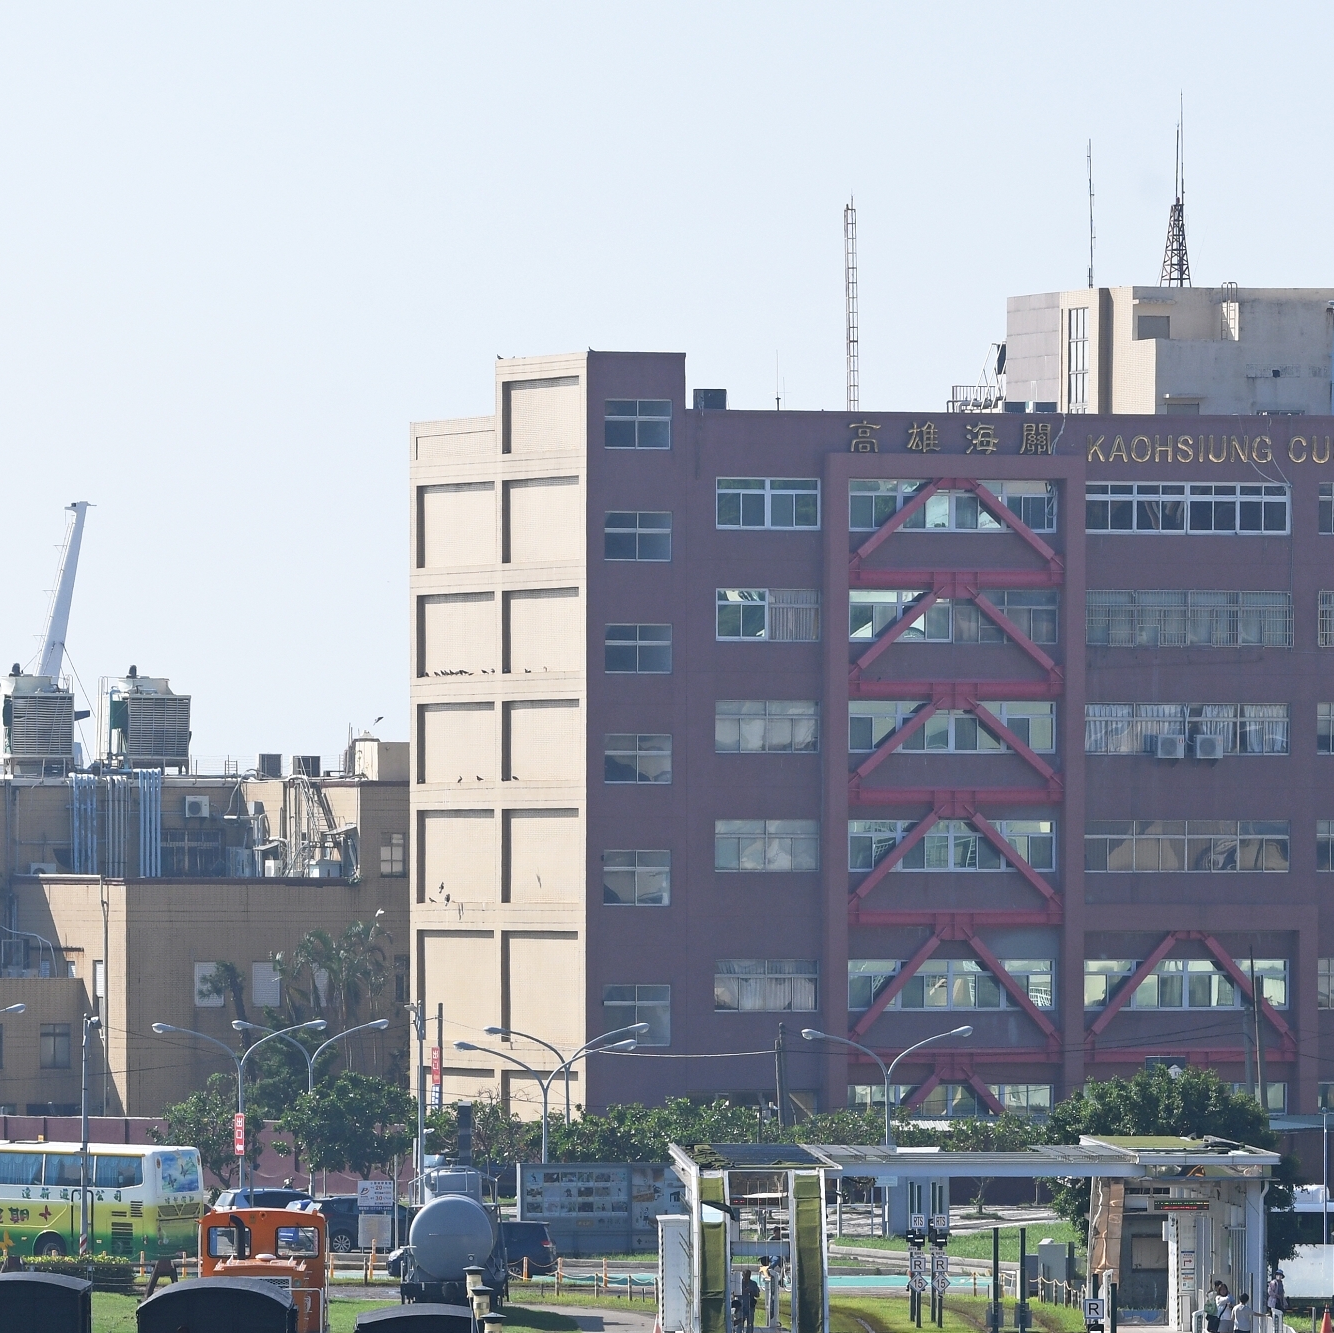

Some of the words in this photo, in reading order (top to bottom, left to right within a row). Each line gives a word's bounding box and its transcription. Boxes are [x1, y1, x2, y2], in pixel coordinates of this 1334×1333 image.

[848, 420, 1054, 456] 高雄海關
[1087, 434, 1273, 465] KAOHSIUNG
[432, 1050, 439, 1070] 出口
[236, 1117, 243, 1139] 出口
[913, 1216, 924, 1227] RTS
[936, 1216, 946, 1227] RTS
[913, 1260, 922, 1270] R
[936, 1260, 945, 1270] R
[913, 1279, 924, 1289] 15
[936, 1279, 946, 1289] 15
[1088, 1302, 1099, 1315] R
